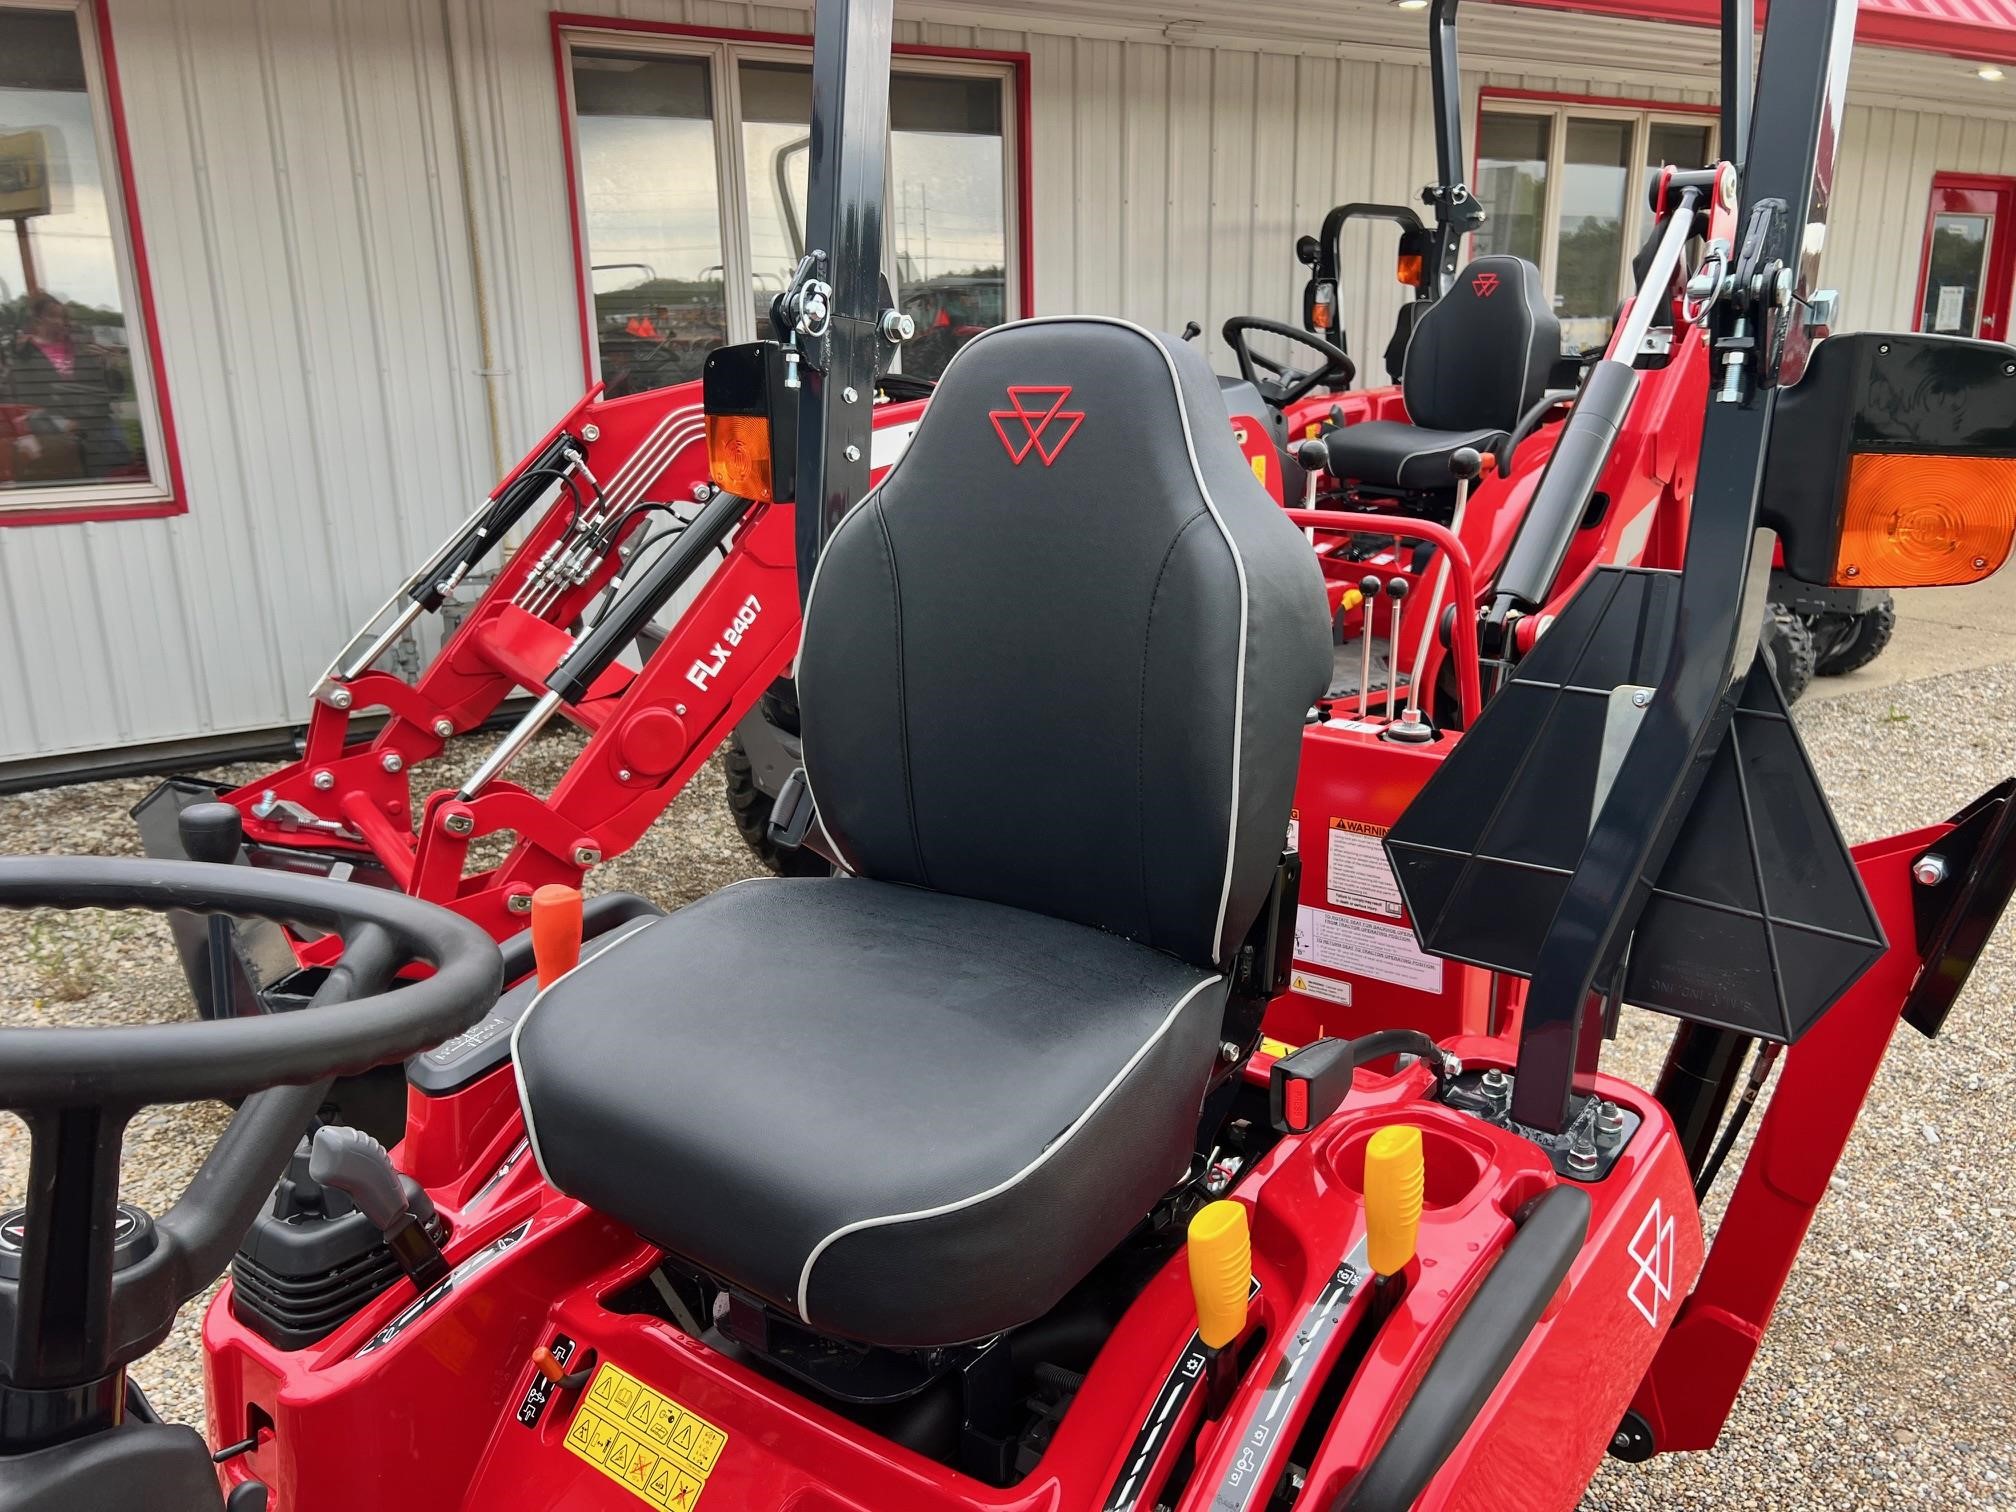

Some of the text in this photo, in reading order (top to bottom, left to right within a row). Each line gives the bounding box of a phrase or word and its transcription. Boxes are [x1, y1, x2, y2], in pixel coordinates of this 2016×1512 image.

[686, 594, 762, 692] FLX 2407
[1346, 821, 1390, 837] WARNIN
